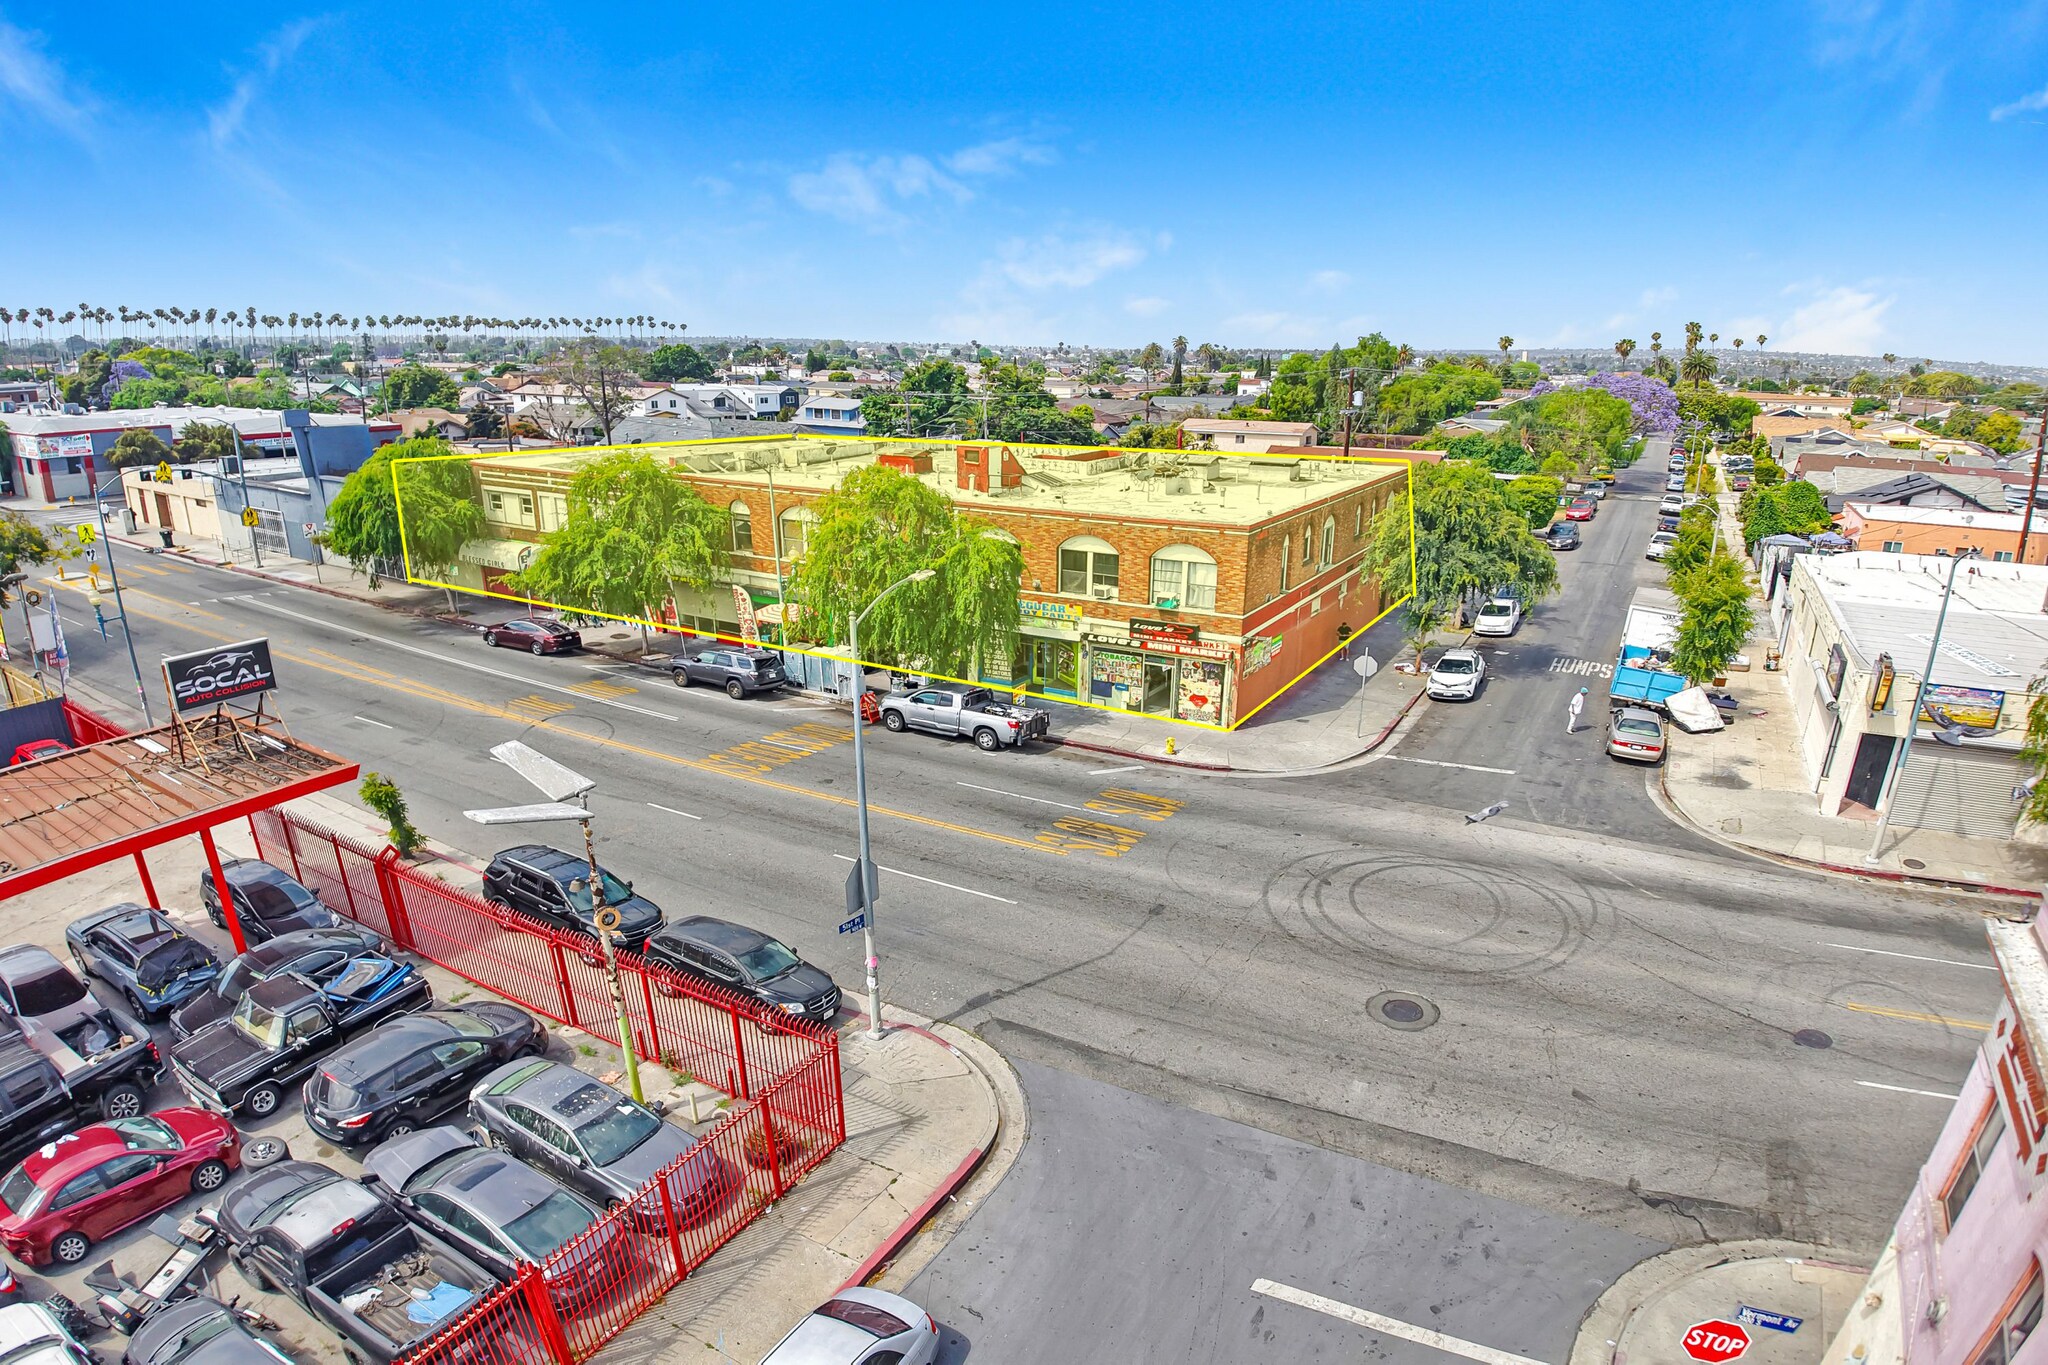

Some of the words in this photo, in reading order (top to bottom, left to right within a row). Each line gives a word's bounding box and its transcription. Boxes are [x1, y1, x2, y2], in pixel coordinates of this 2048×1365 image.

[462, 554, 485, 565] BLESSED
[487, 559, 505, 568] GIRLS
[1042, 611, 1081, 621] PARTS
[1155, 636, 1194, 645] MARKET
[1099, 651, 1138, 663] TOBACCO
[1147, 642, 1176, 652] MINI
[1179, 646, 1232, 660] MARKET
[1548, 657, 1613, 679] HUMPS
[175, 664, 272, 698] SOCAL
[185, 692, 213, 704] AUTO
[215, 680, 266, 697] COLLISION
[1741, 1307, 1783, 1326] Vermont
[1783, 1318, 1799, 1329] Av
[1686, 1329, 1746, 1354] STOP
